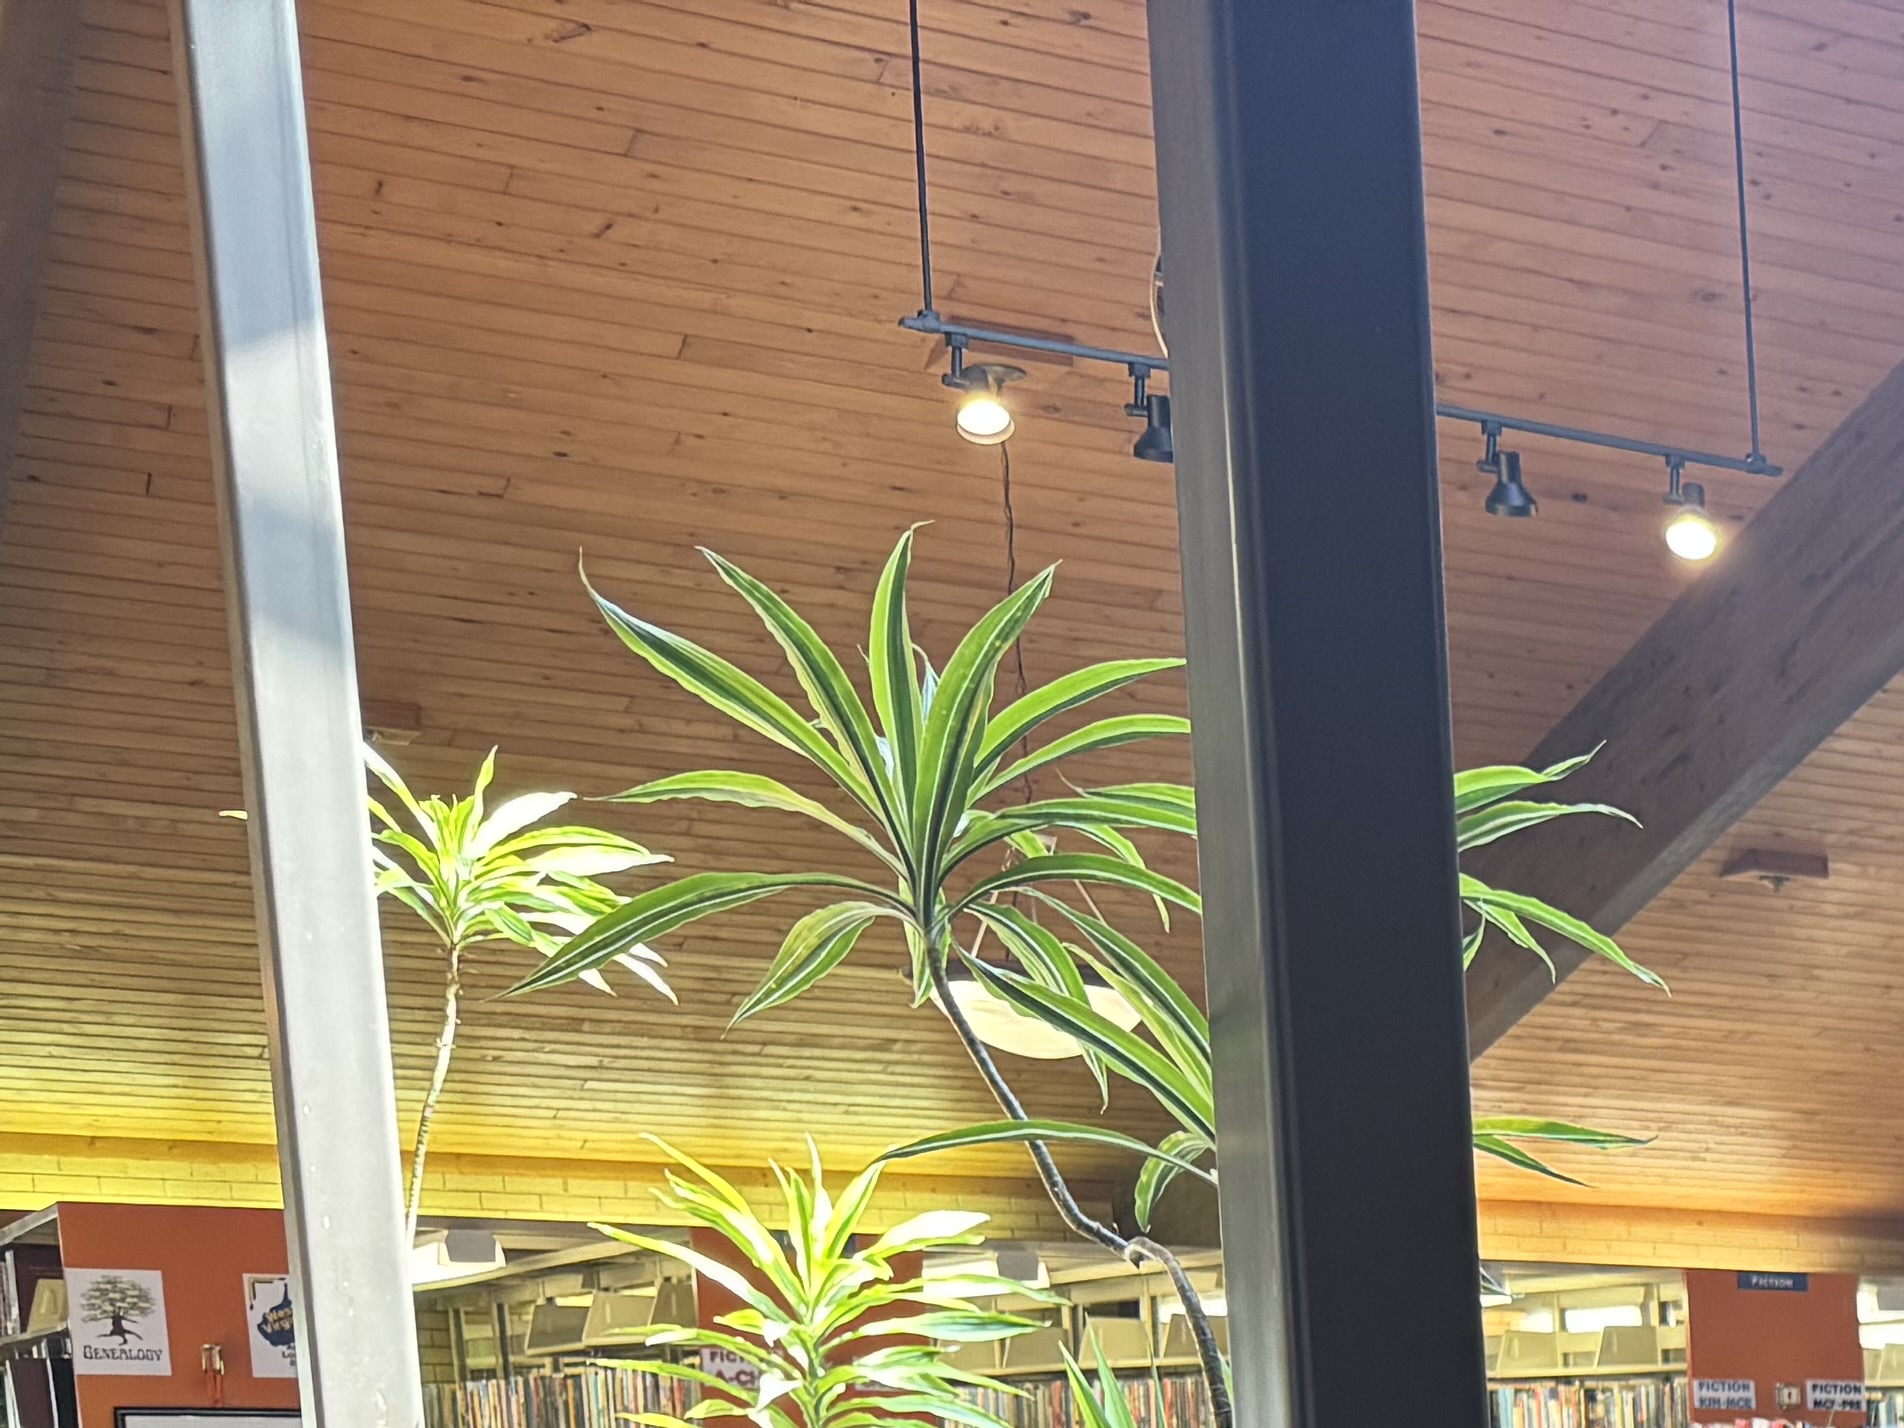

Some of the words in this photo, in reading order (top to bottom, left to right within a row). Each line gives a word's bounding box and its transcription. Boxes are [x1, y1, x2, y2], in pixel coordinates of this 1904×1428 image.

[83, 1345, 163, 1362] GENEALOGY
[1698, 1380, 1751, 1392] FICTION
[1811, 1383, 1863, 1395] FICTION
